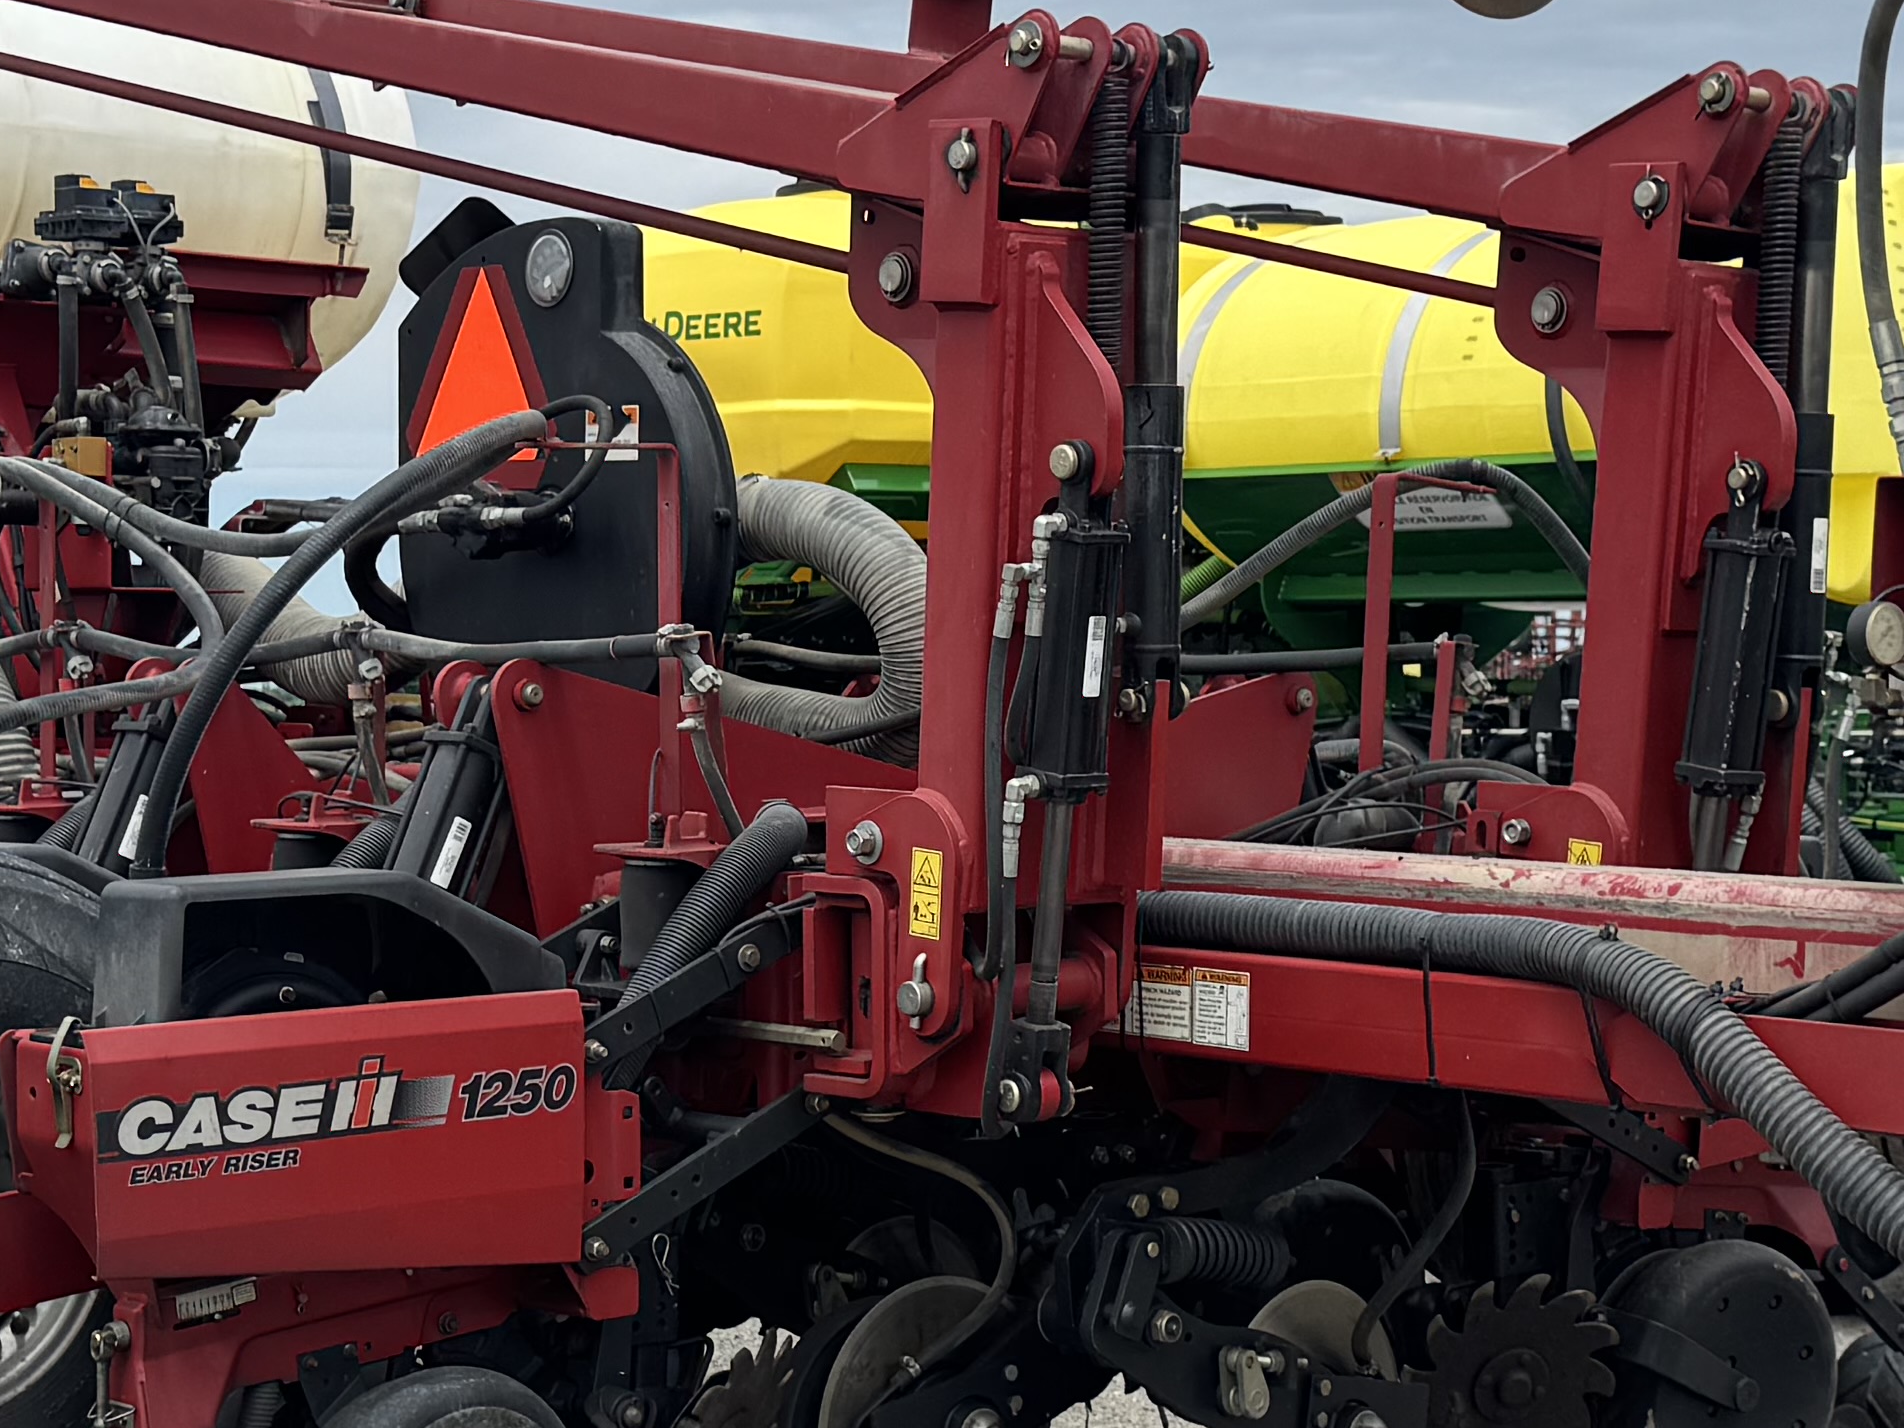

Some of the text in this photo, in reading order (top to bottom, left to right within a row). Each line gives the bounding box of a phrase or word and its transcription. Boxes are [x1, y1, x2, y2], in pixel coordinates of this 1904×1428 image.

[663, 309, 762, 341] DEERE
[116, 1081, 327, 1157] CASE
[459, 1064, 577, 1123] 1250
[127, 1146, 302, 1187] EARLY RISER
